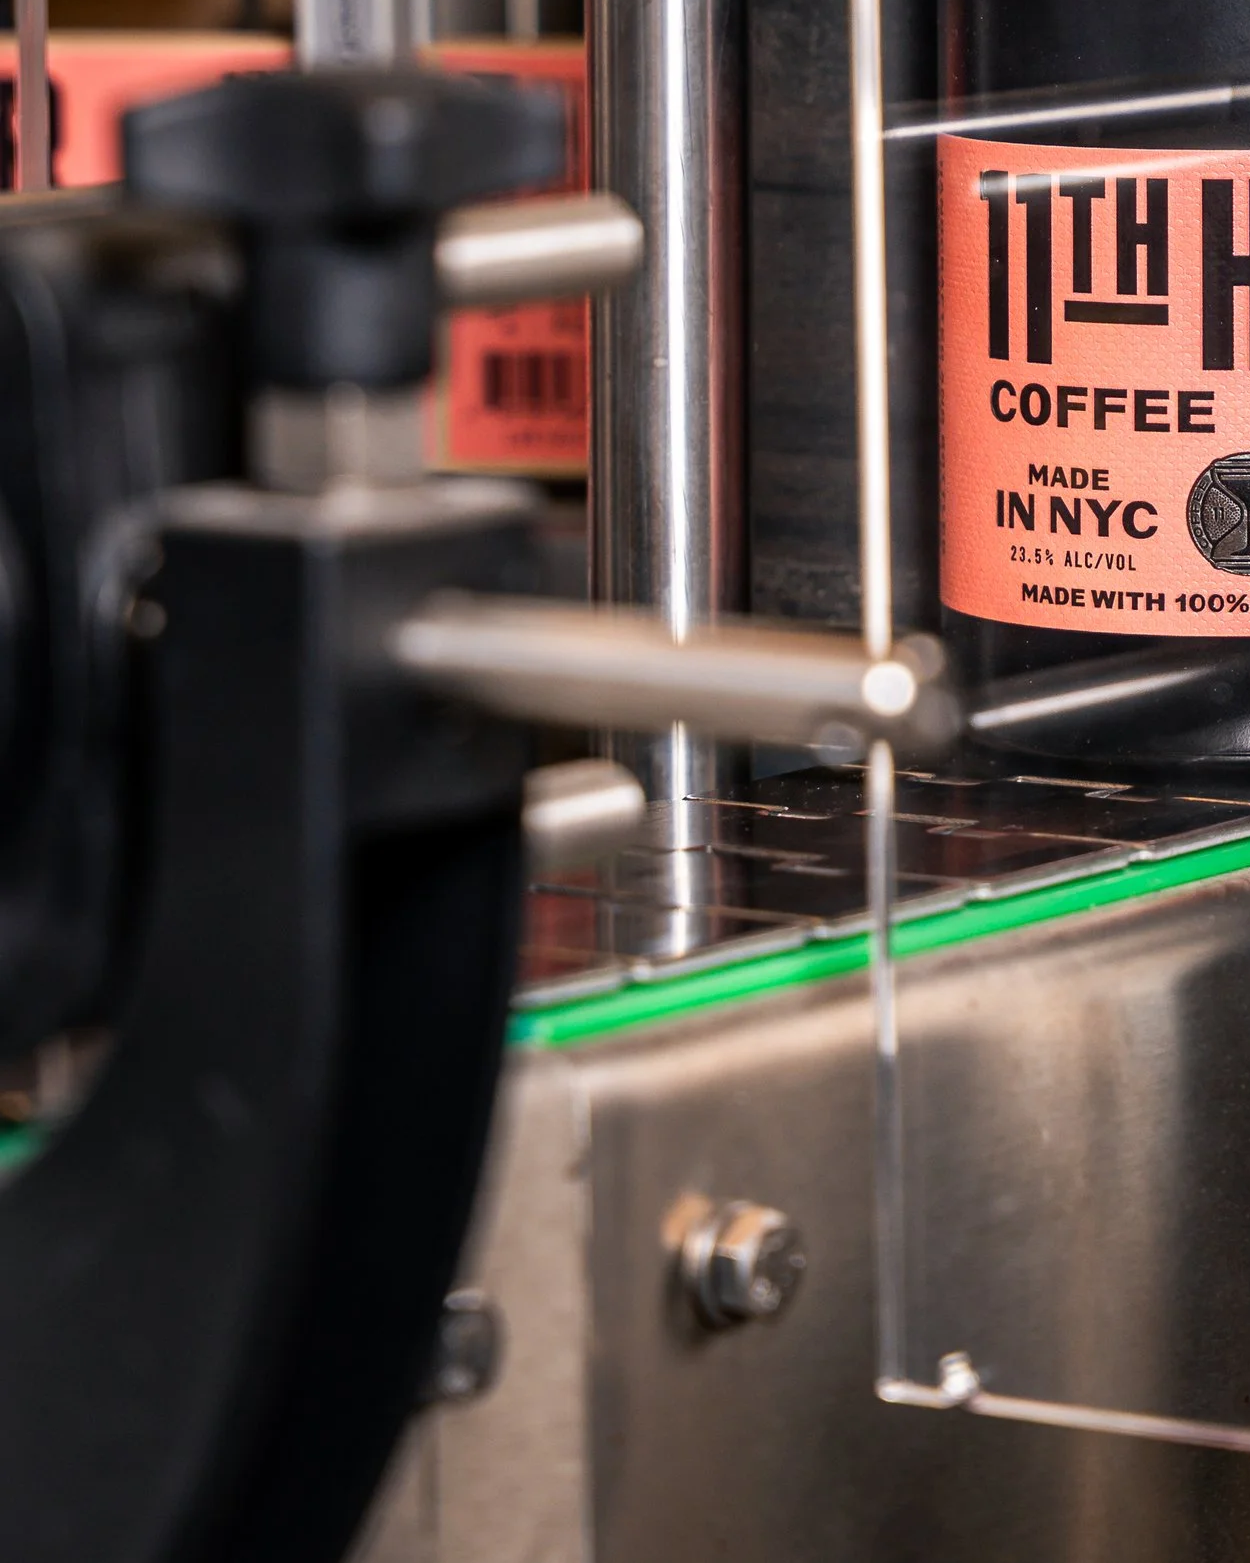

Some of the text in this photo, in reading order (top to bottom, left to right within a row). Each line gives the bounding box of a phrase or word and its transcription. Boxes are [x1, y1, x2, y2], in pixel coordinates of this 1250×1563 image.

[990, 379, 1215, 434] COFFEE
[1029, 463, 1110, 491] MADE
[997, 489, 1158, 539] IN NYC
[1191, 477, 1209, 549] COFFEE
[1011, 545, 1136, 572] 23.5% ALC/VOL
[1022, 583, 1086, 607] MADE
[1091, 589, 1166, 612] WITH
[1175, 593, 1249, 614] 100%
